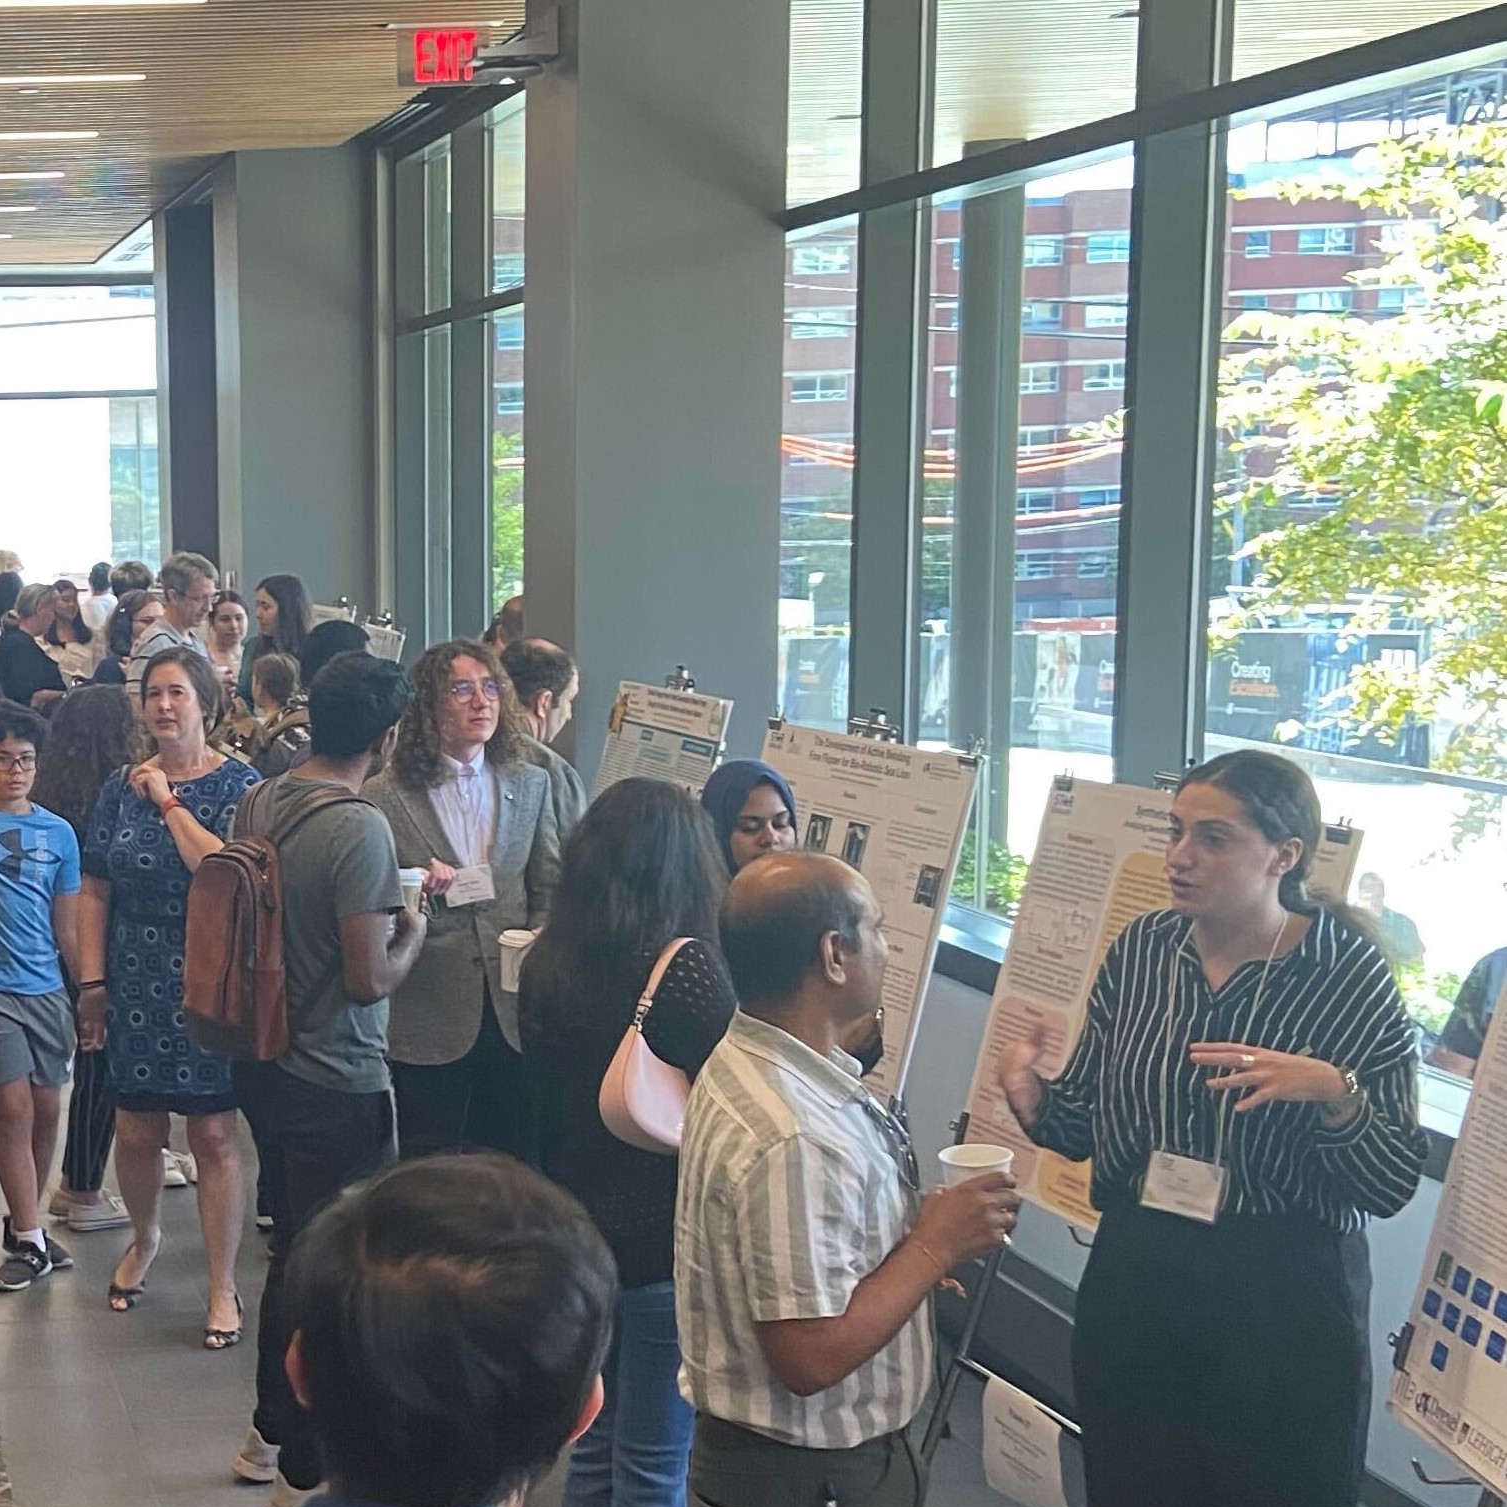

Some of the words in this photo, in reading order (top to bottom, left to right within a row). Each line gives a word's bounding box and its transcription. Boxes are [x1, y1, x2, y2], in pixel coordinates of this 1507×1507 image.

[414, 30, 477, 82] EXIT
[1231, 660, 1272, 682] Creating
[1467, 1427, 1507, 1469] LEHIGH
